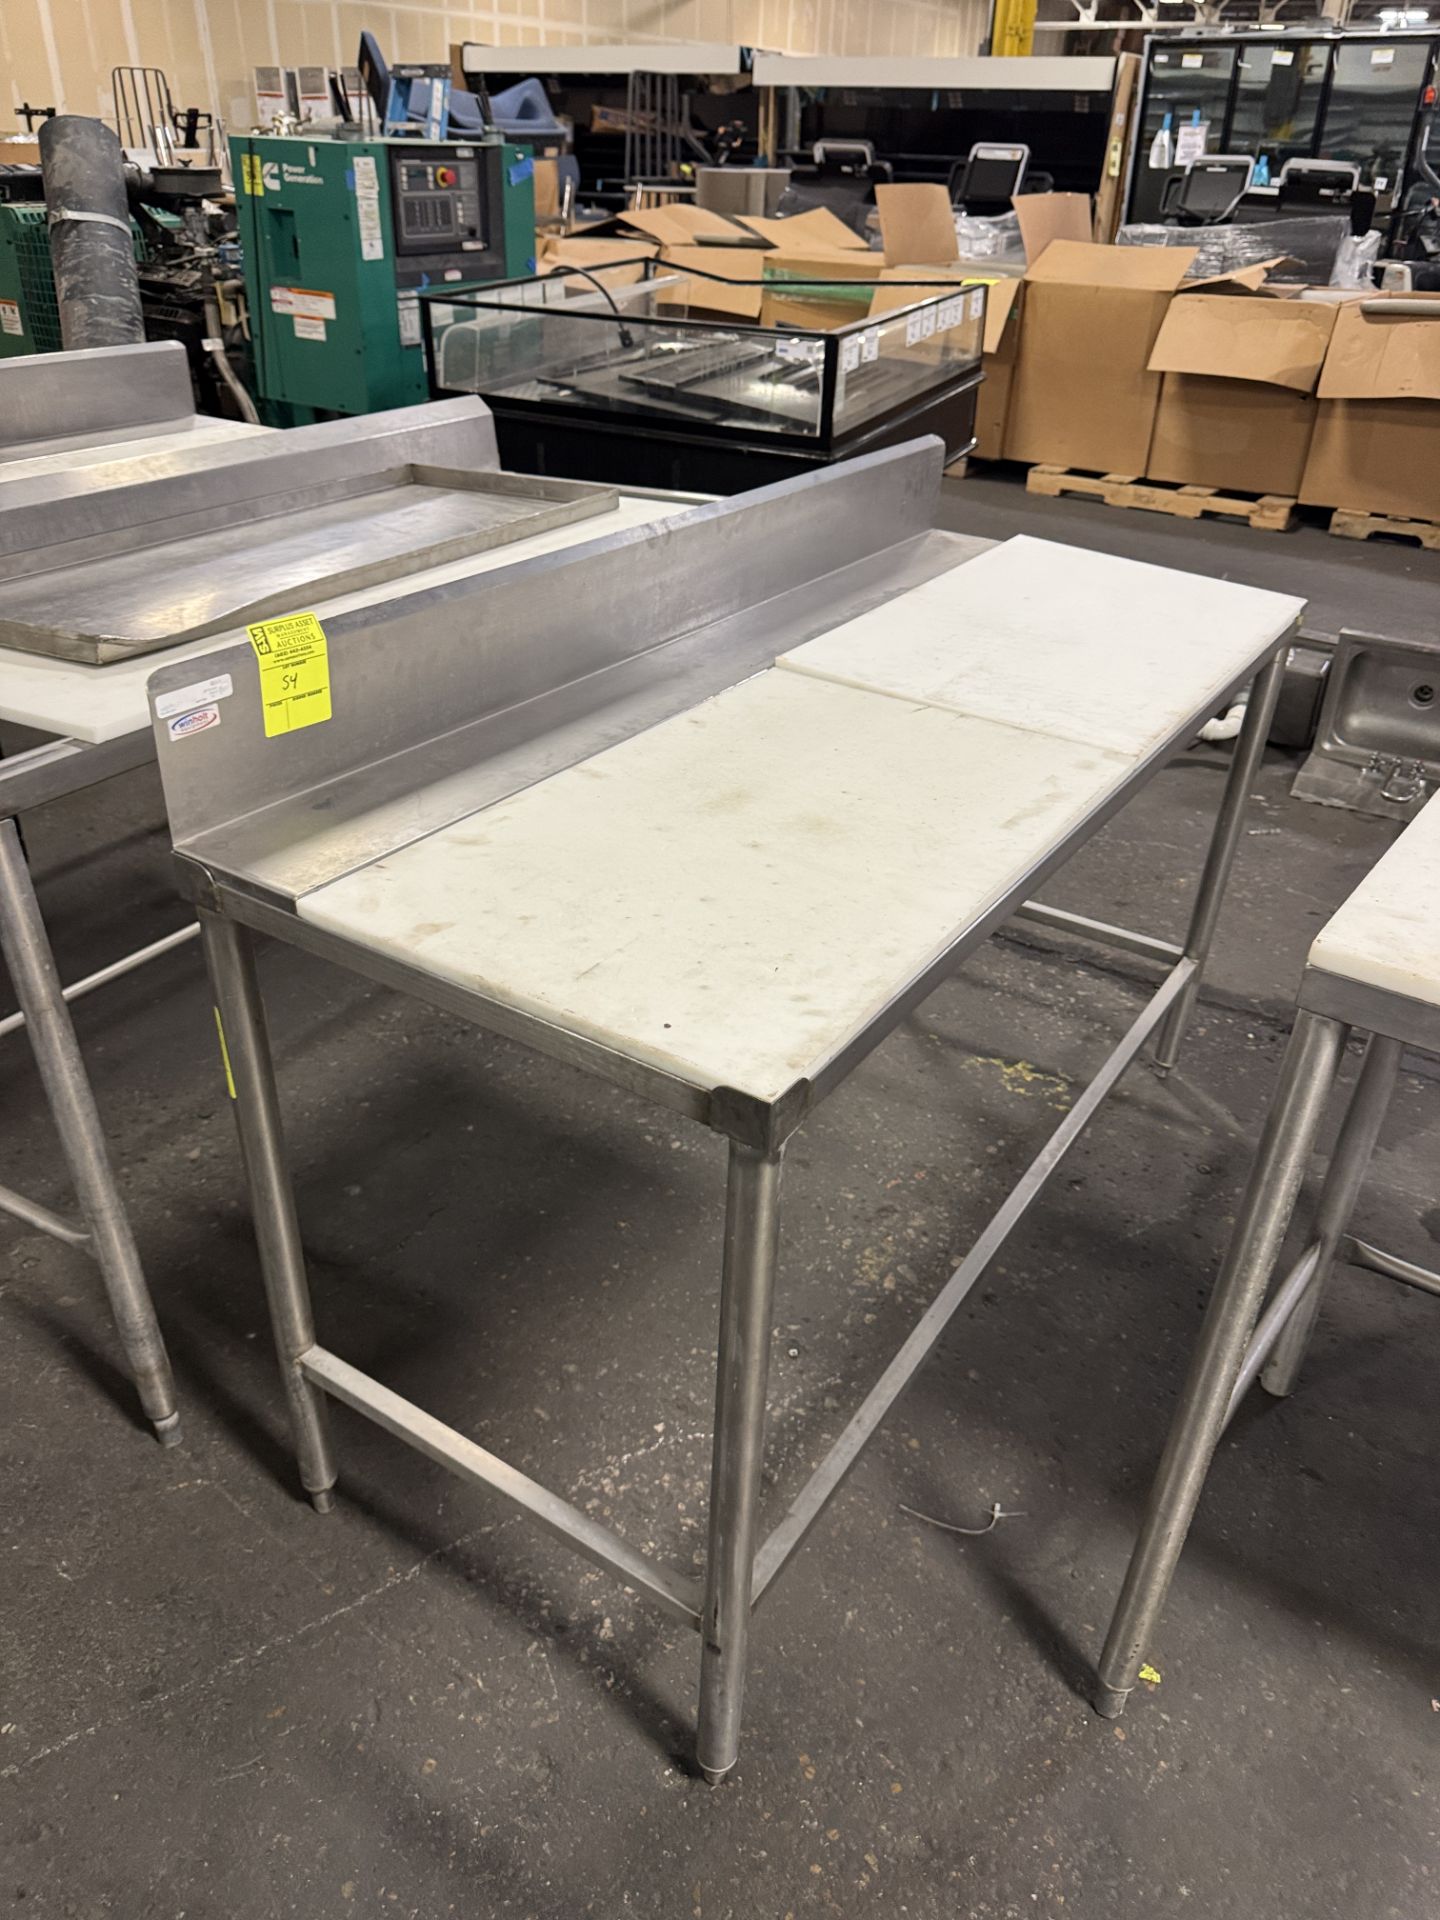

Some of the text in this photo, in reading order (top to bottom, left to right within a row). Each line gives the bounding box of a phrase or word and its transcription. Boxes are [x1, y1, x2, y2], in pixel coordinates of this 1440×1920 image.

[283, 173, 324, 185] Generation
[267, 617, 314, 635] SURPLUS ASSET
[276, 632, 316, 648] AUCTIONS
